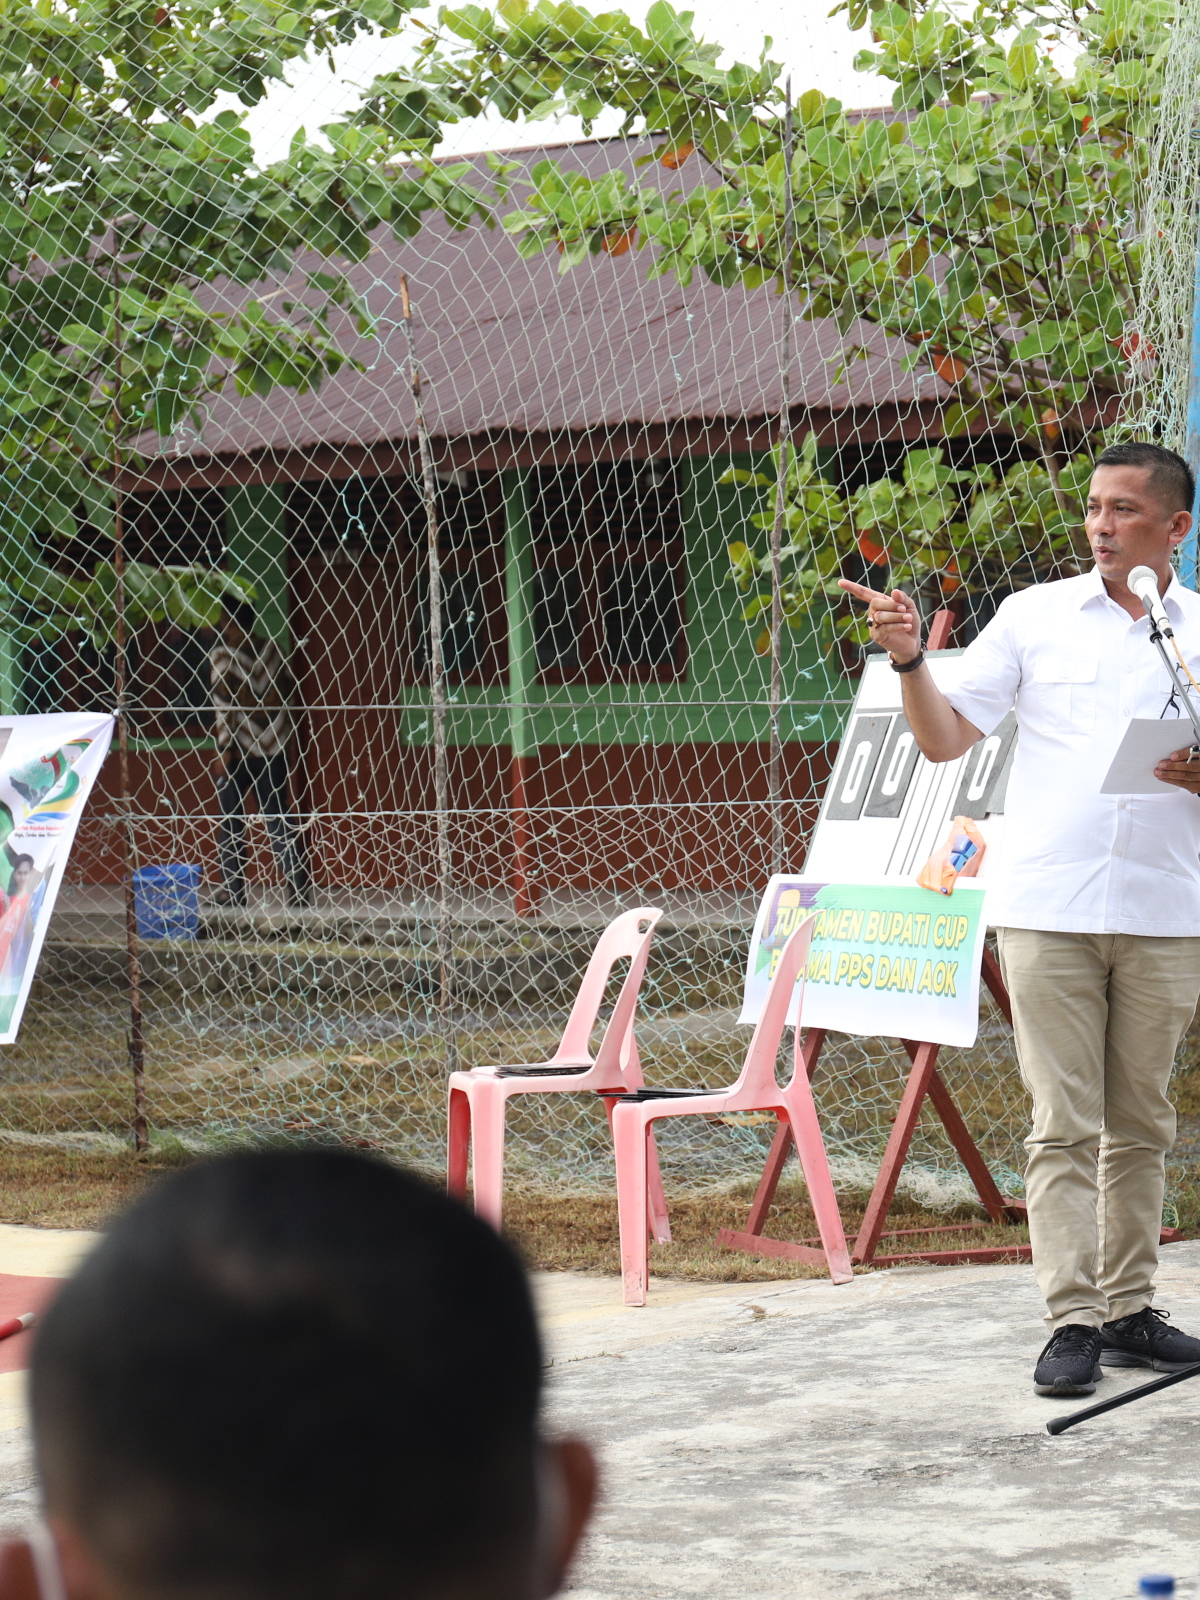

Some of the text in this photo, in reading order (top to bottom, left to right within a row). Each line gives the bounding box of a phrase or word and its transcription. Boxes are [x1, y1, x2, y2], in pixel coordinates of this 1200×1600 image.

[864, 910, 931, 948] BUPATI
[932, 914, 969, 951] CUP
[834, 952, 875, 989] PPS
[874, 955, 917, 993] DAN
[917, 959, 959, 998] AOK
